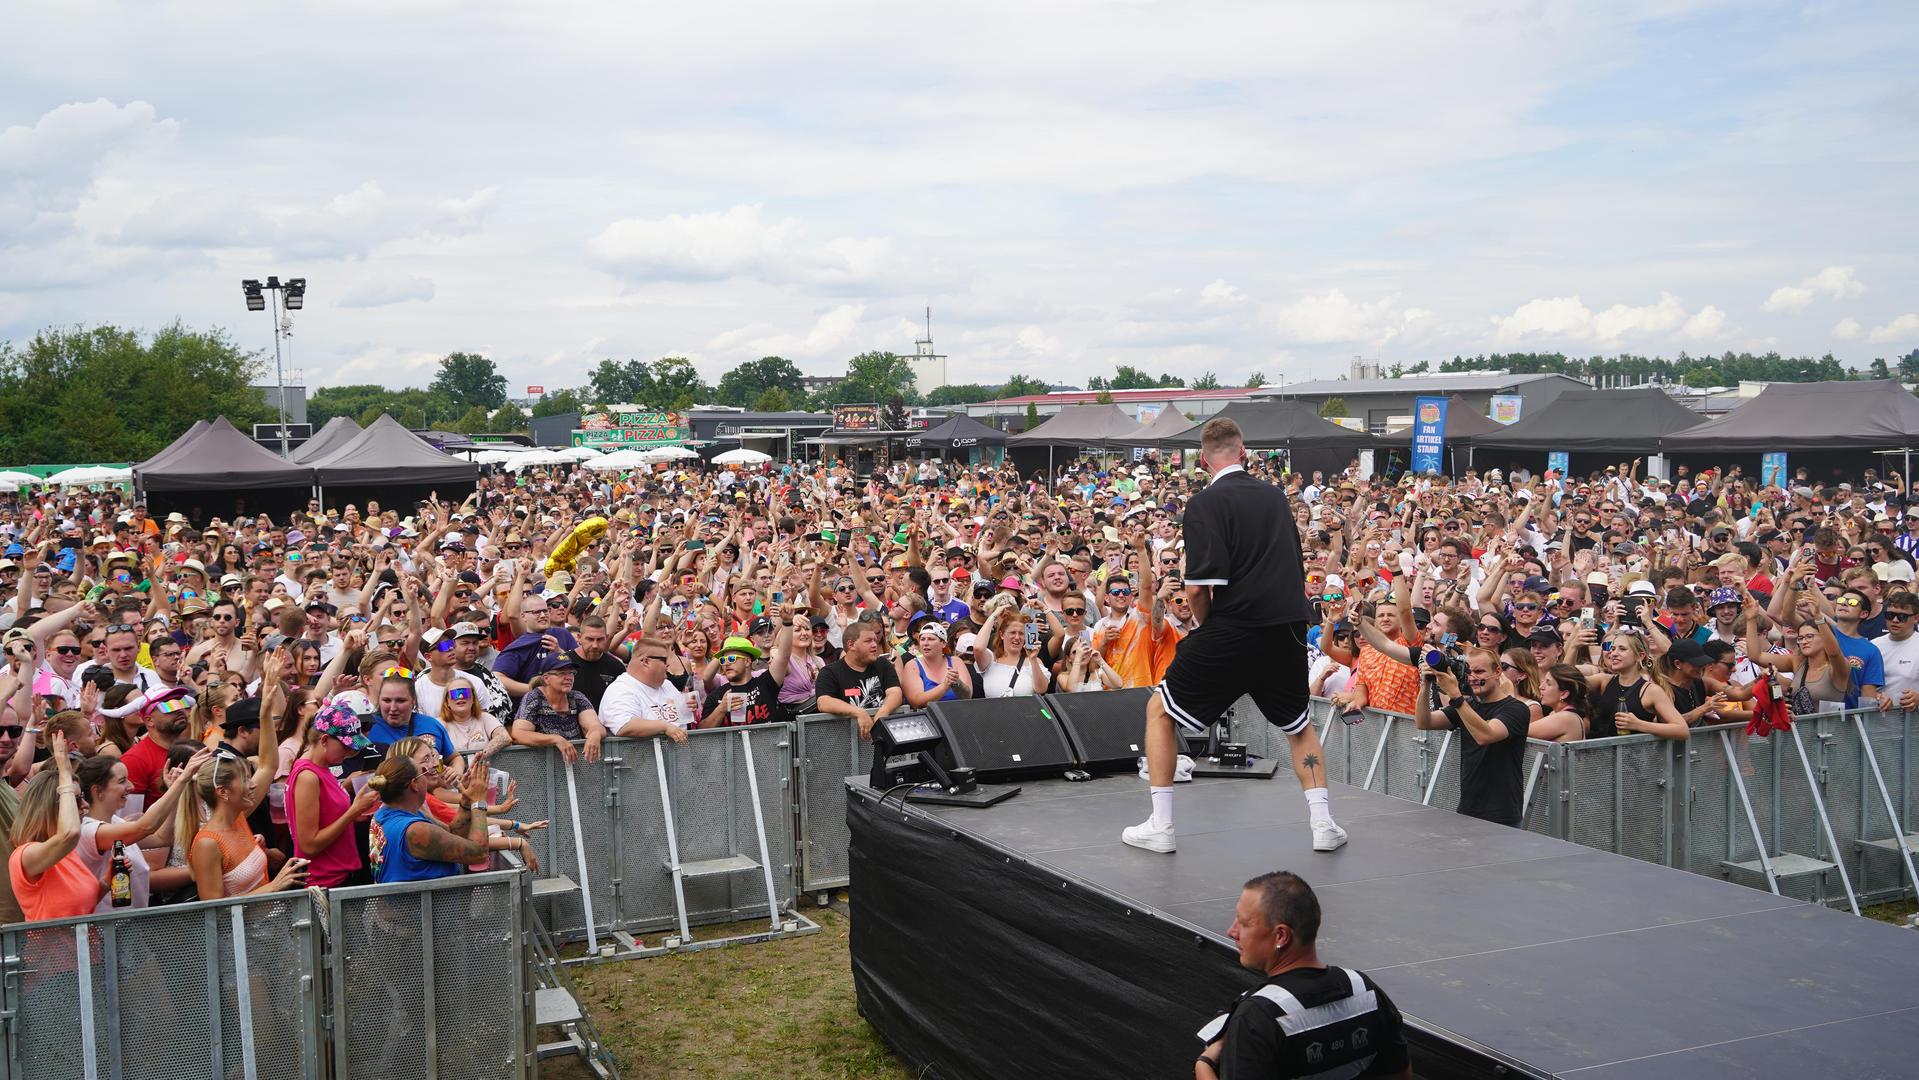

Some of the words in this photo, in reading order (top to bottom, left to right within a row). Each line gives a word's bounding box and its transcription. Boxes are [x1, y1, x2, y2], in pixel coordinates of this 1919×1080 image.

[620, 413, 669, 425] PIZZA
[275, 430, 292, 438] WK
[624, 429, 665, 440] PIZZA
[1417, 445, 1438, 453] STAND
